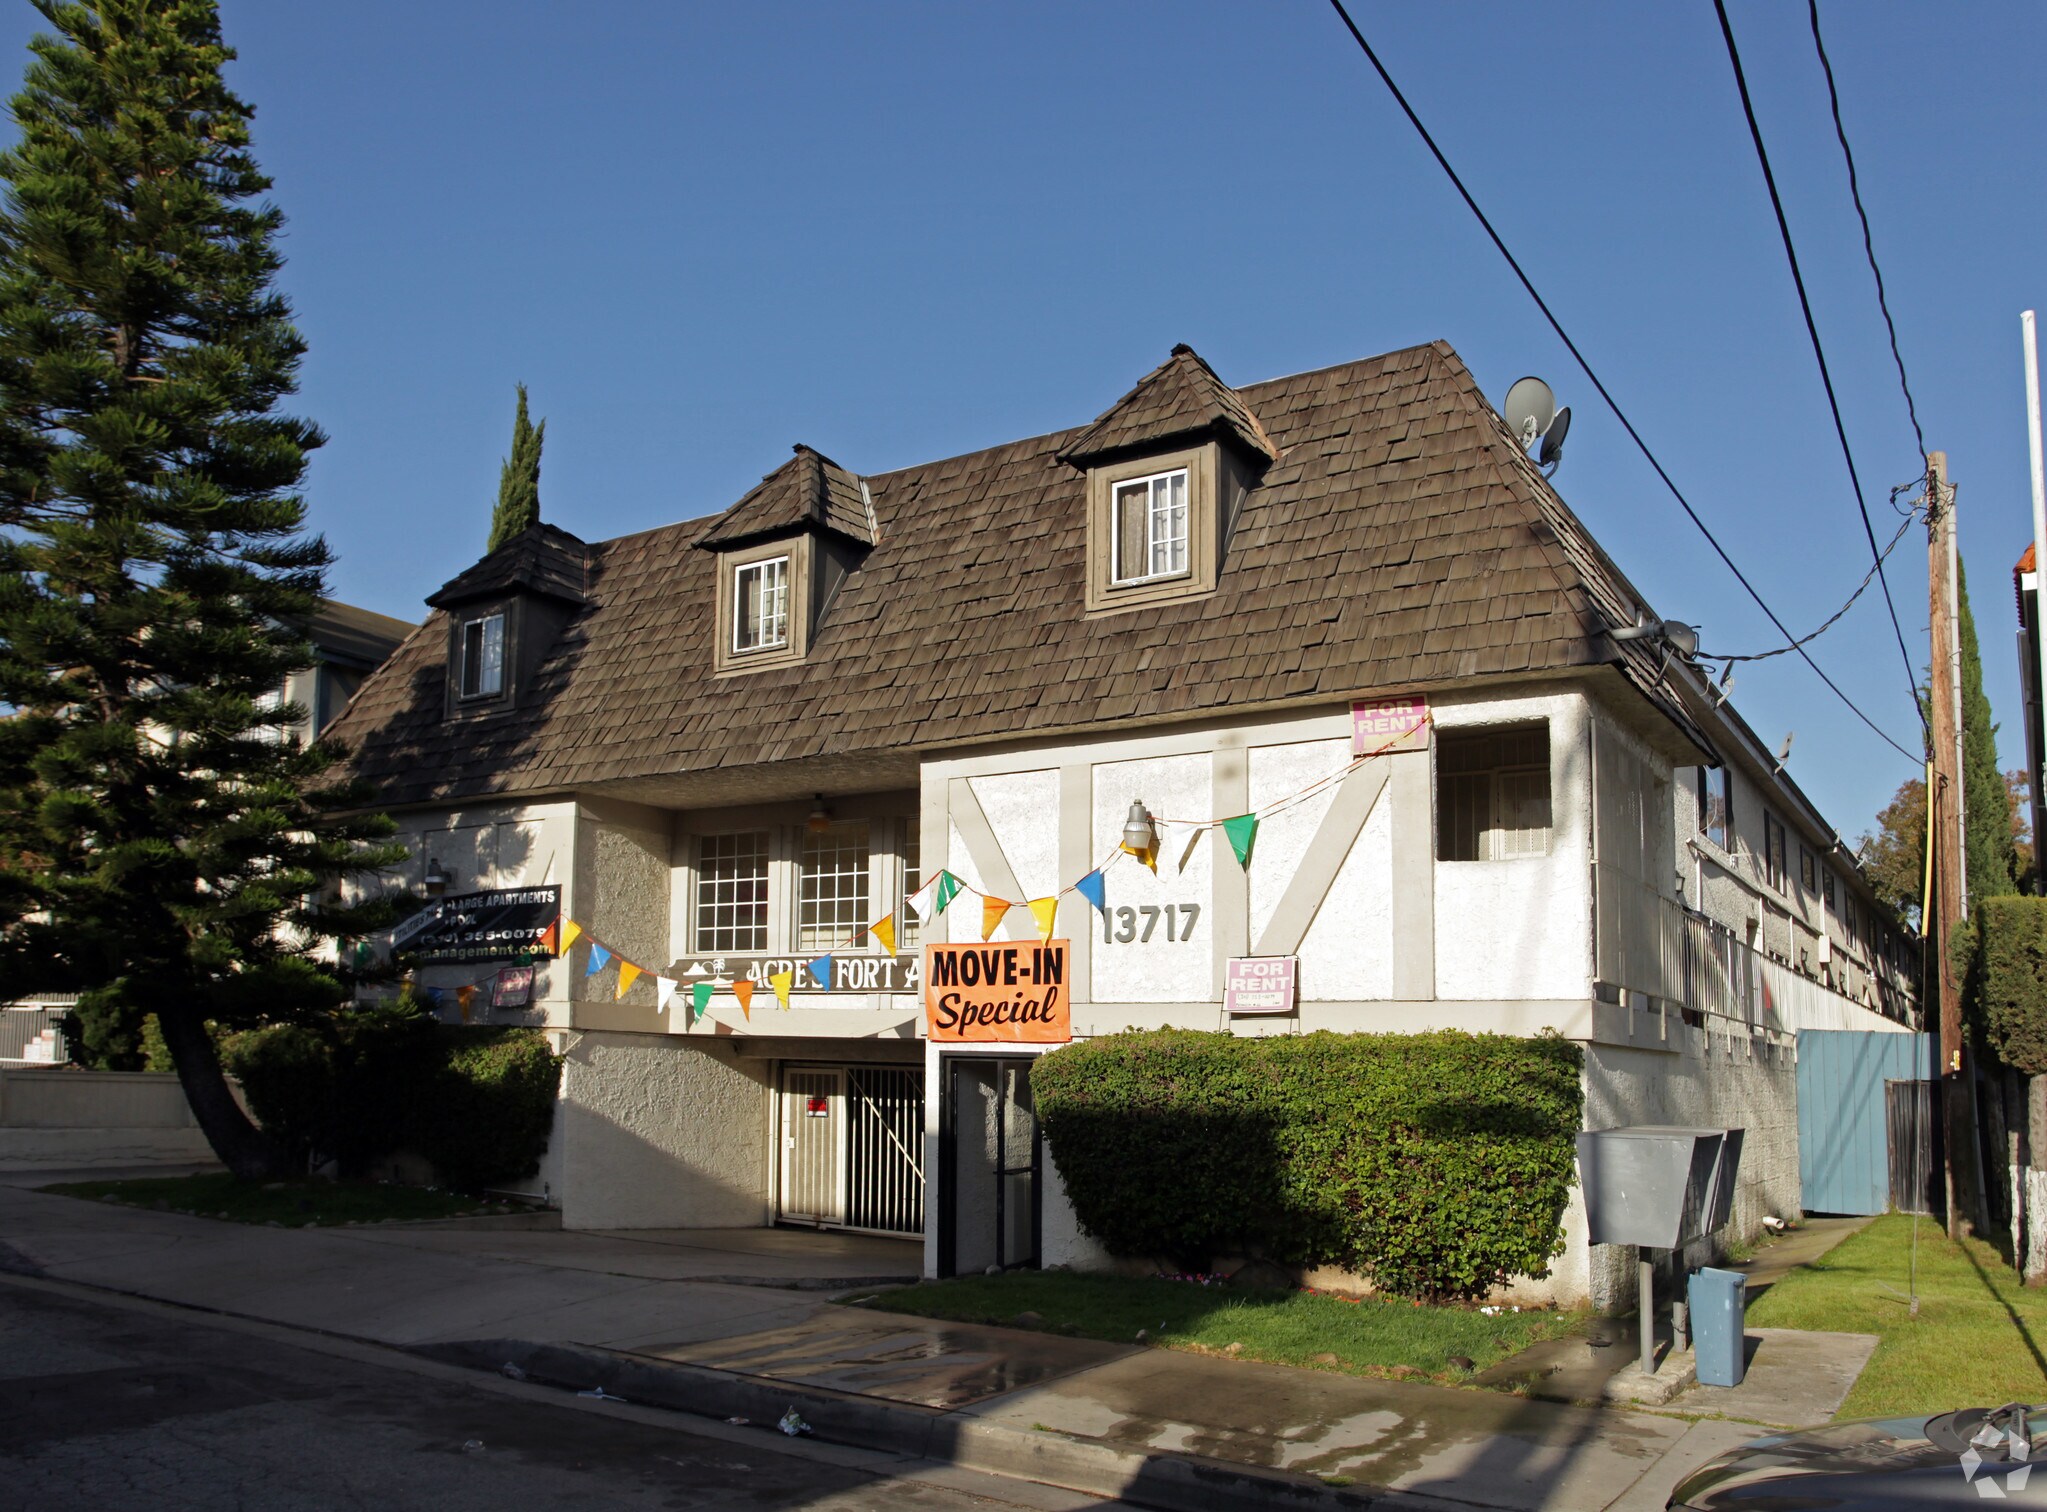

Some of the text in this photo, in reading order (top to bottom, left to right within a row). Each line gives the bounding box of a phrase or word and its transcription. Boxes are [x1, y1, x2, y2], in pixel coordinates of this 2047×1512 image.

[1364, 700, 1413, 718] FOR
[1358, 714, 1422, 734] RENT
[451, 896, 484, 911] LARGE
[486, 890, 555, 907] APARTMENTS
[450, 914, 477, 927] POOL
[1104, 903, 1201, 944] 13717
[464, 927, 548, 942] 355-0079
[835, 958, 898, 990] FORT
[931, 947, 1063, 987] MOVE-IN
[1239, 962, 1284, 977] FOR
[1230, 976, 1290, 992] RENT
[935, 986, 1058, 1037] Special
